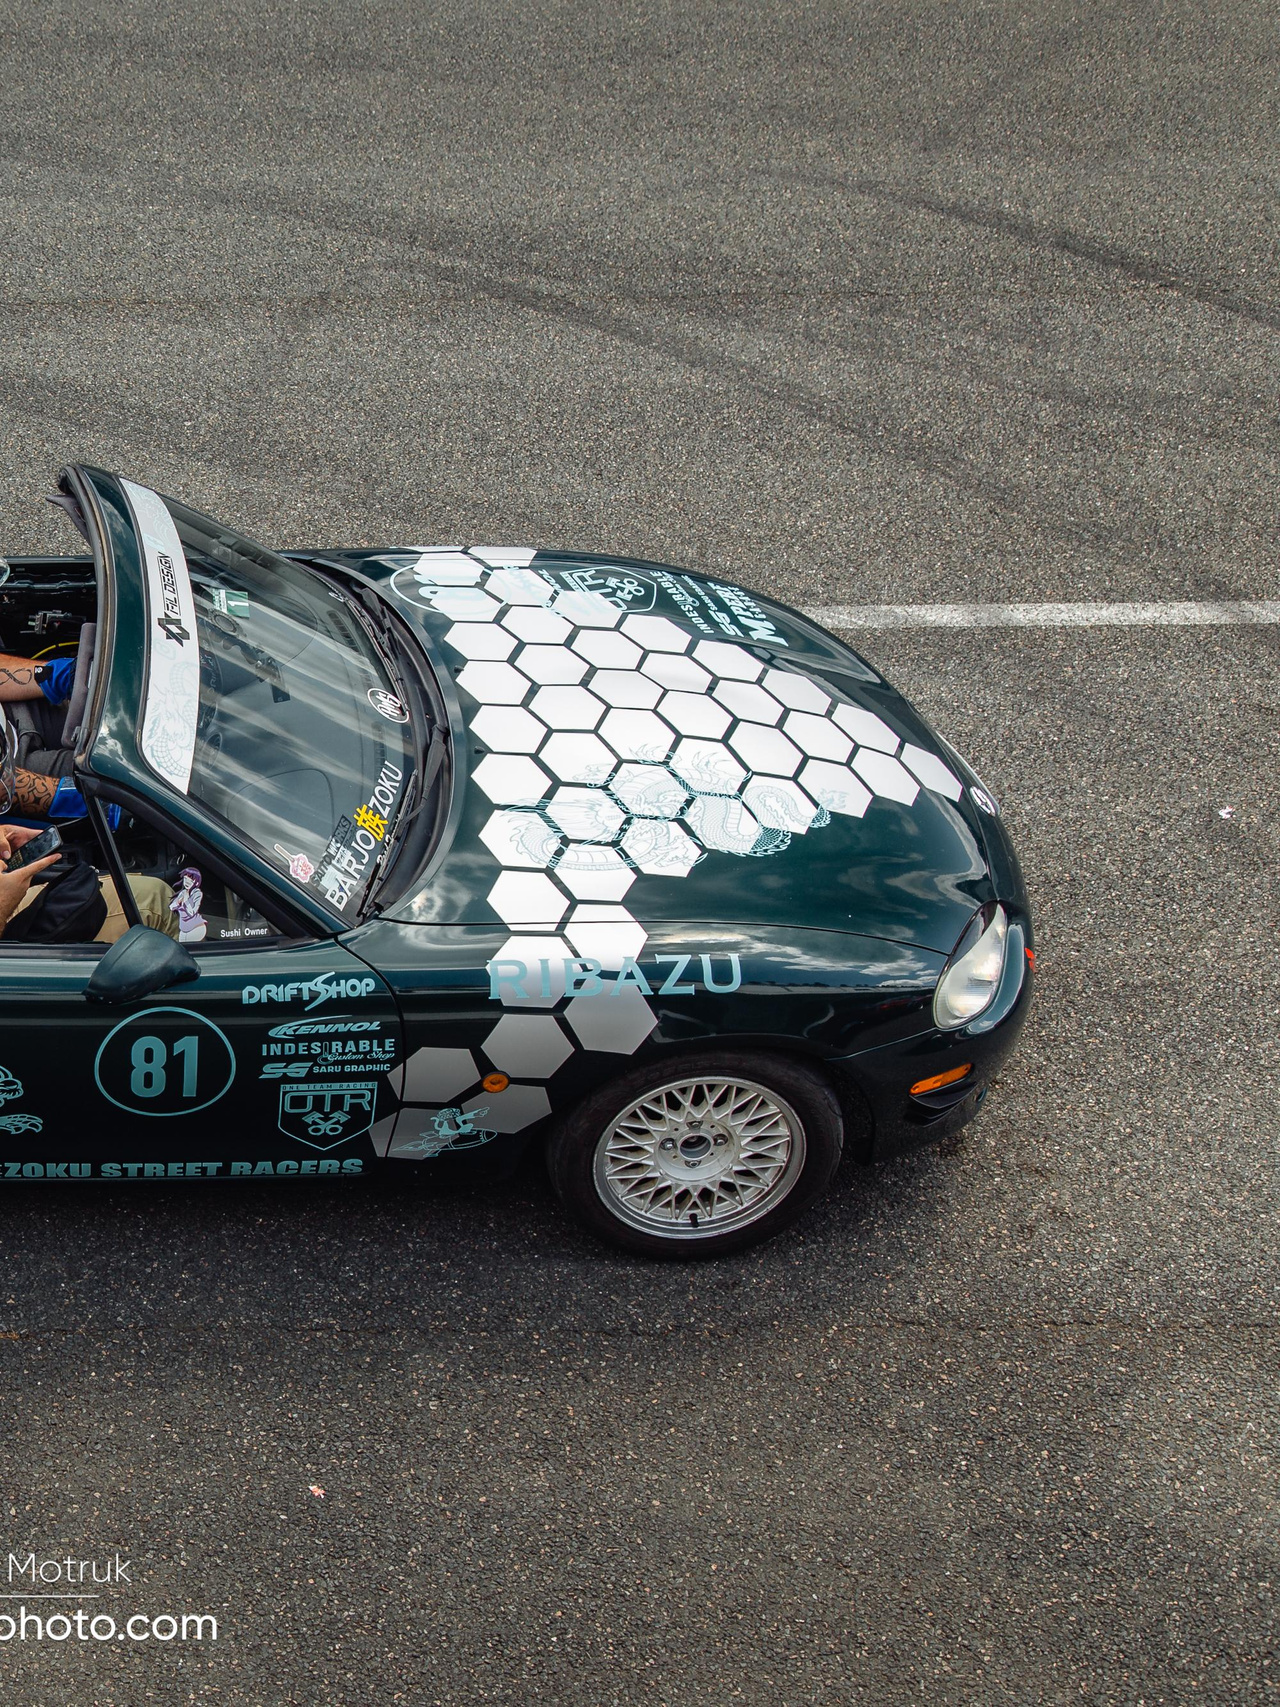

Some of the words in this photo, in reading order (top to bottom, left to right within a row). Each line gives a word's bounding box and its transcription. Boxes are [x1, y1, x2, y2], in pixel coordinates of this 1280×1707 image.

[220, 928, 241, 938] Sushi
[244, 927, 268, 936] Owner
[486, 953, 742, 1001] RIBAZU
[242, 971, 376, 1012] DRIFTSHOP
[272, 1020, 381, 1038] KENNOL
[367, 1050, 396, 1062] Shop
[130, 1035, 199, 1098] 81
[313, 1064, 342, 1074] SARU
[344, 1063, 391, 1073] GRAPHIC
[307, 1083, 334, 1091] TEAM
[284, 1090, 371, 1114] OTR
[101, 1162, 222, 1178] STREET
[230, 1159, 364, 1176] RACERS
